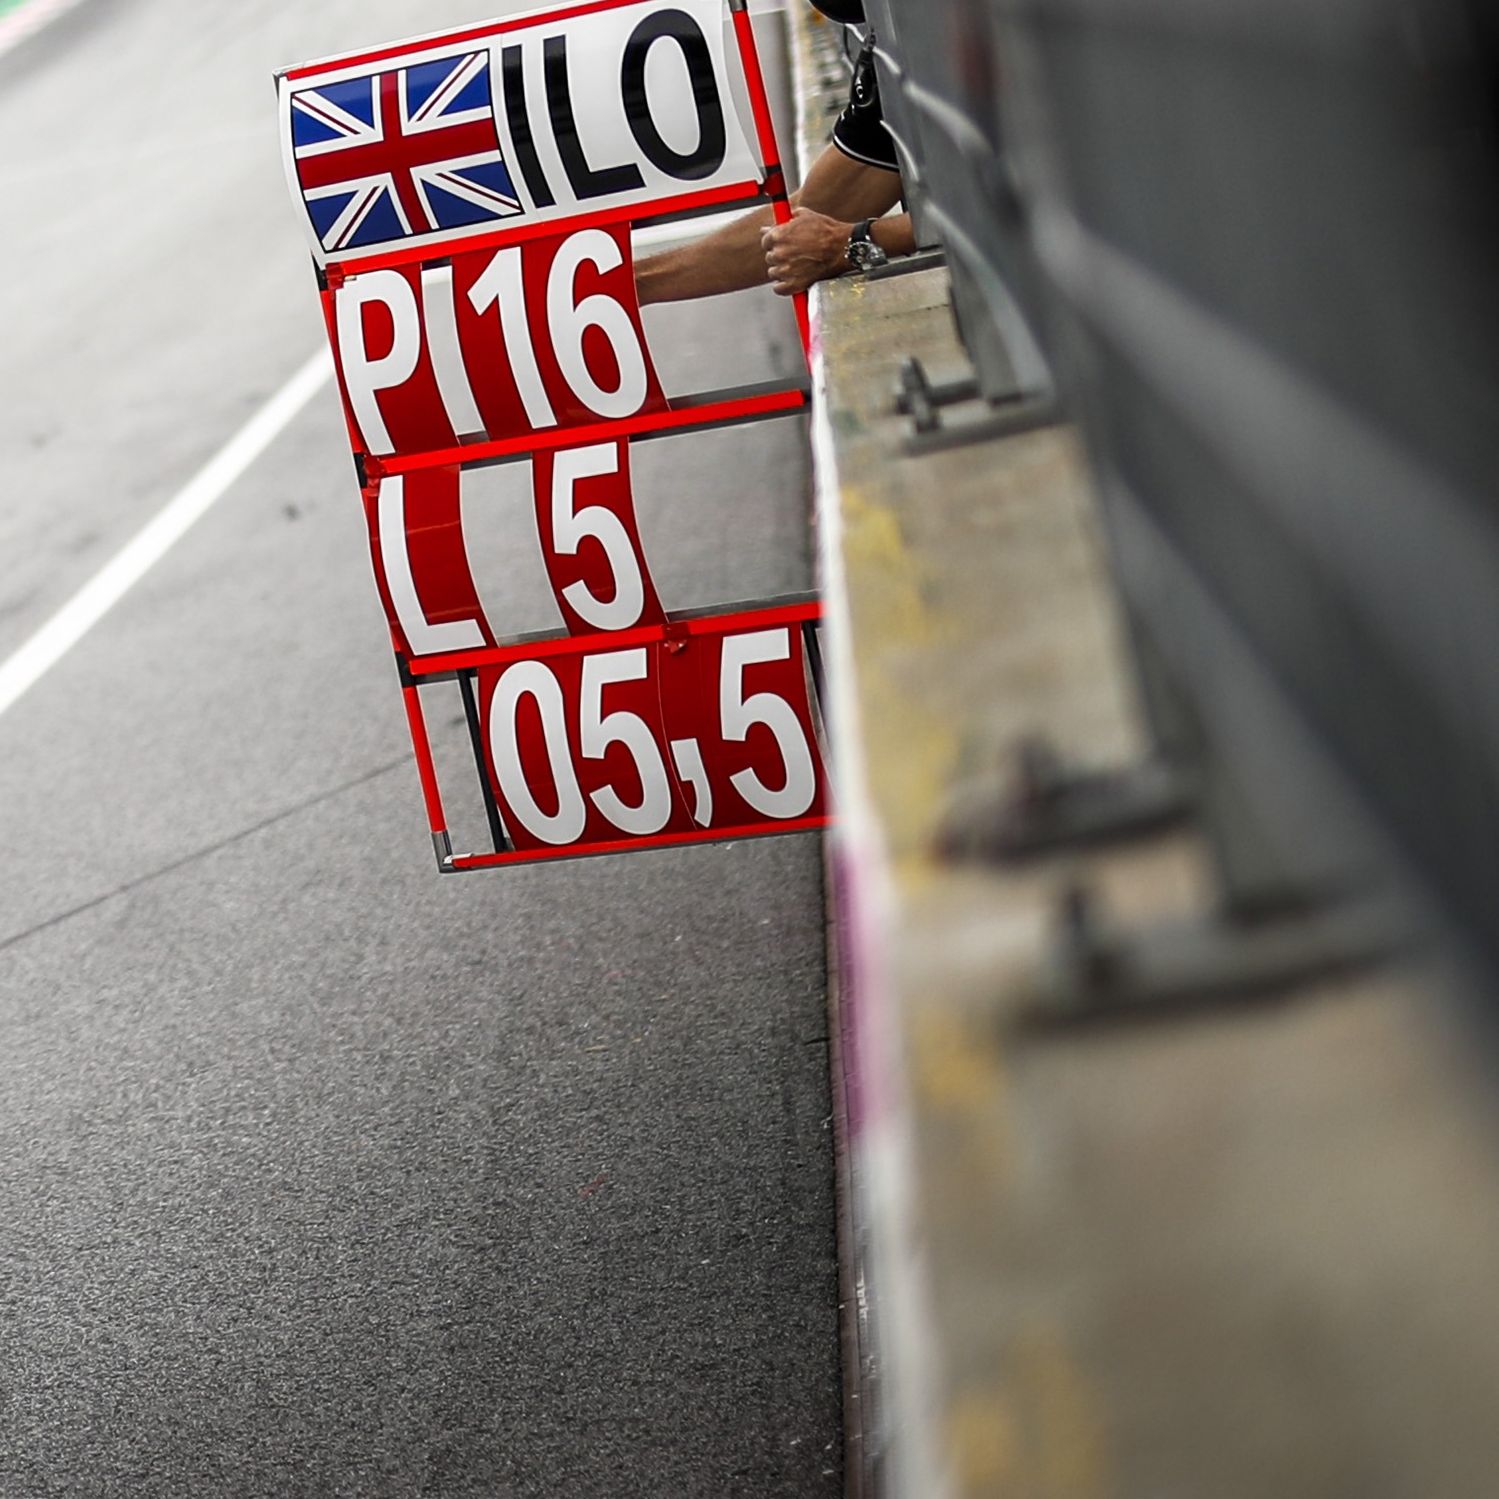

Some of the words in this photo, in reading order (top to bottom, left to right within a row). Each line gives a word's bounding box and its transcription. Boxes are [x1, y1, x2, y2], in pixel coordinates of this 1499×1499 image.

[502, 8, 727, 209] ILO
[378, 474, 487, 656] L
[551, 441, 645, 632] 5
[488, 627, 817, 846] 05,5
